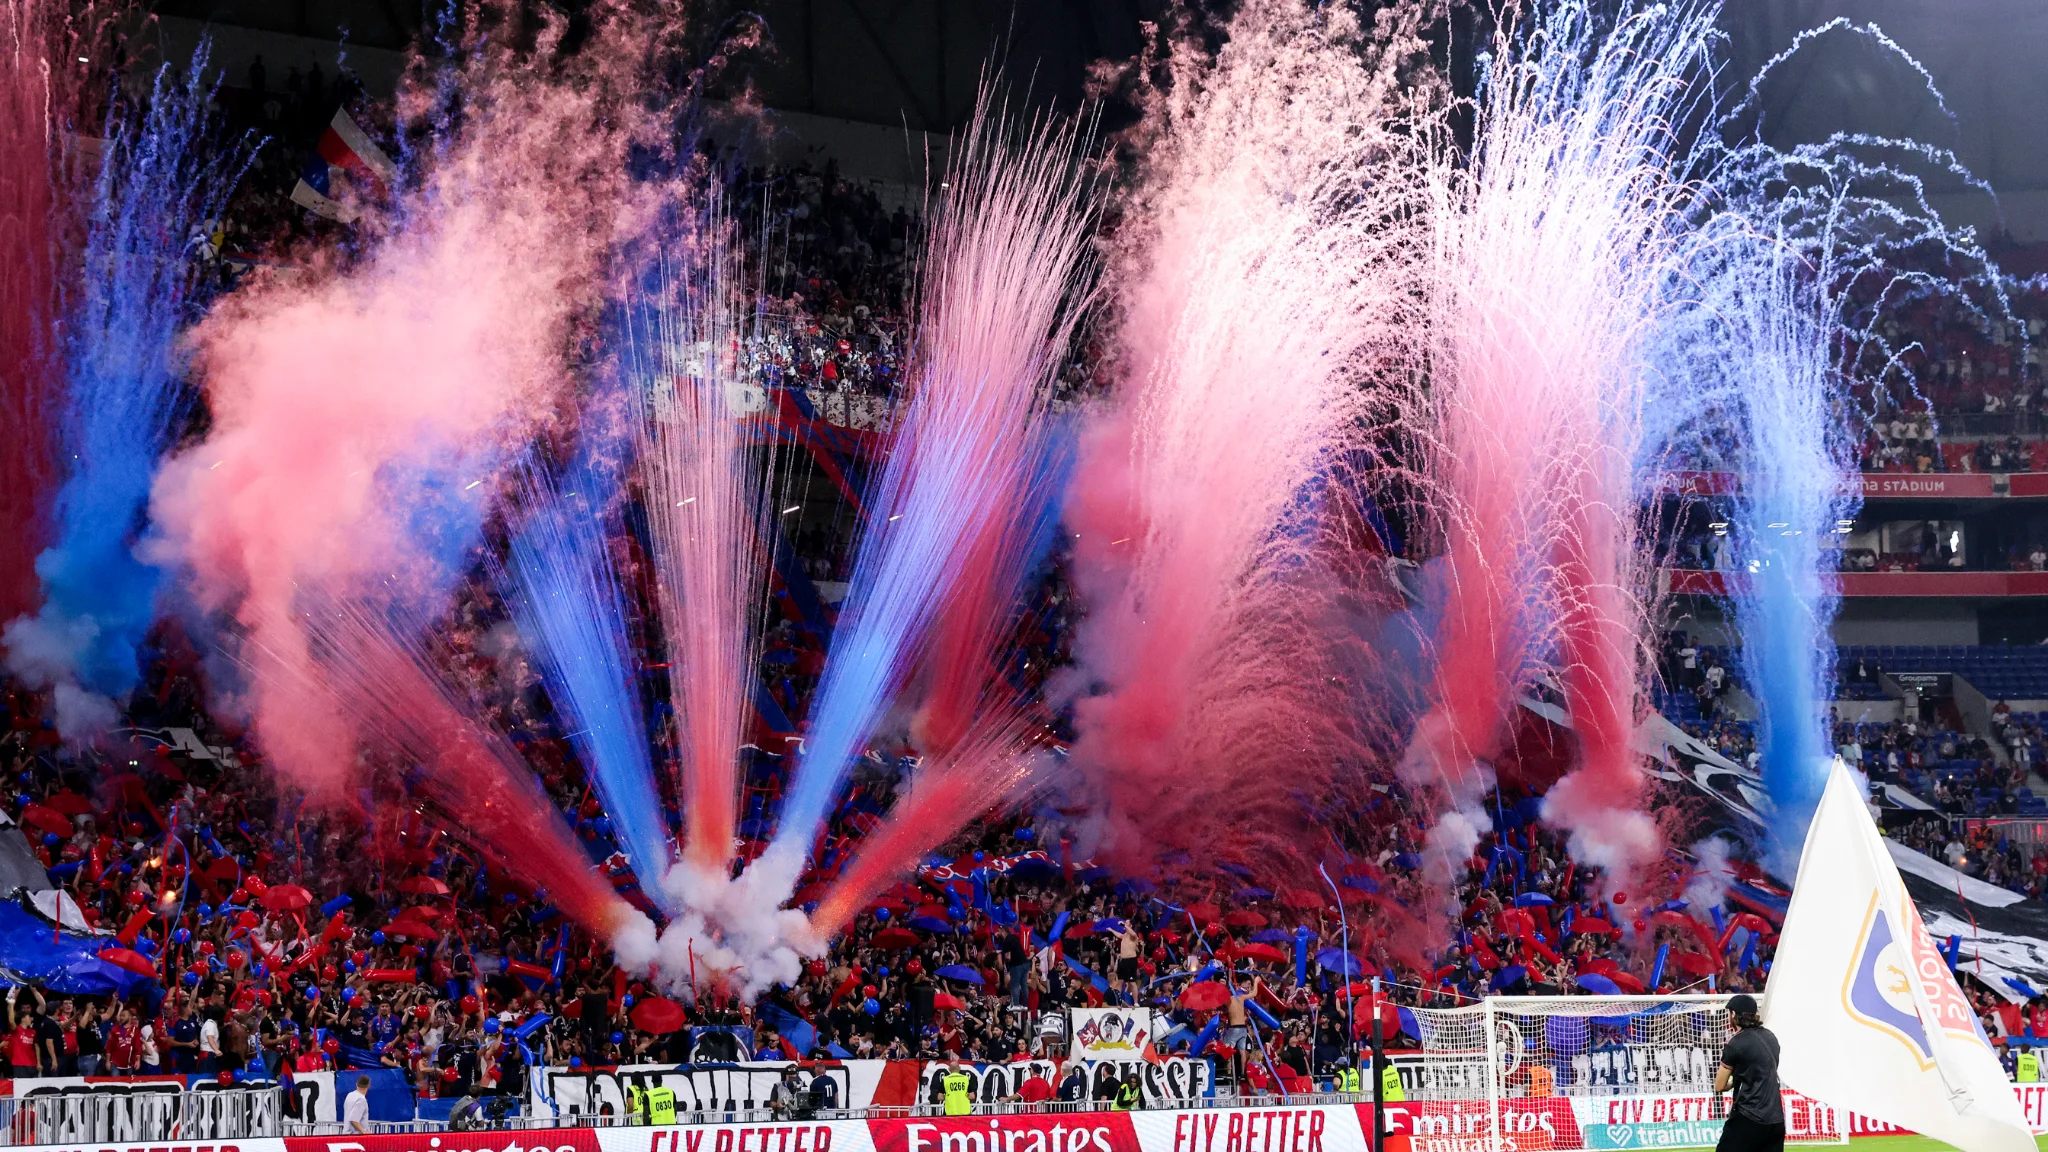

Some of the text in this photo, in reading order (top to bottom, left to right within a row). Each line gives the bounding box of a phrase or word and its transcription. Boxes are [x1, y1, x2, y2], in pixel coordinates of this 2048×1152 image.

[1883, 480, 1944, 491] STADIUM
[824, 1084, 833, 1097] 11
[949, 1082, 965, 1091] 0266
[656, 1100, 672, 1111] 0830
[905, 1119, 1113, 1152] Emirates
[1226, 1110, 1325, 1152] BETTER
